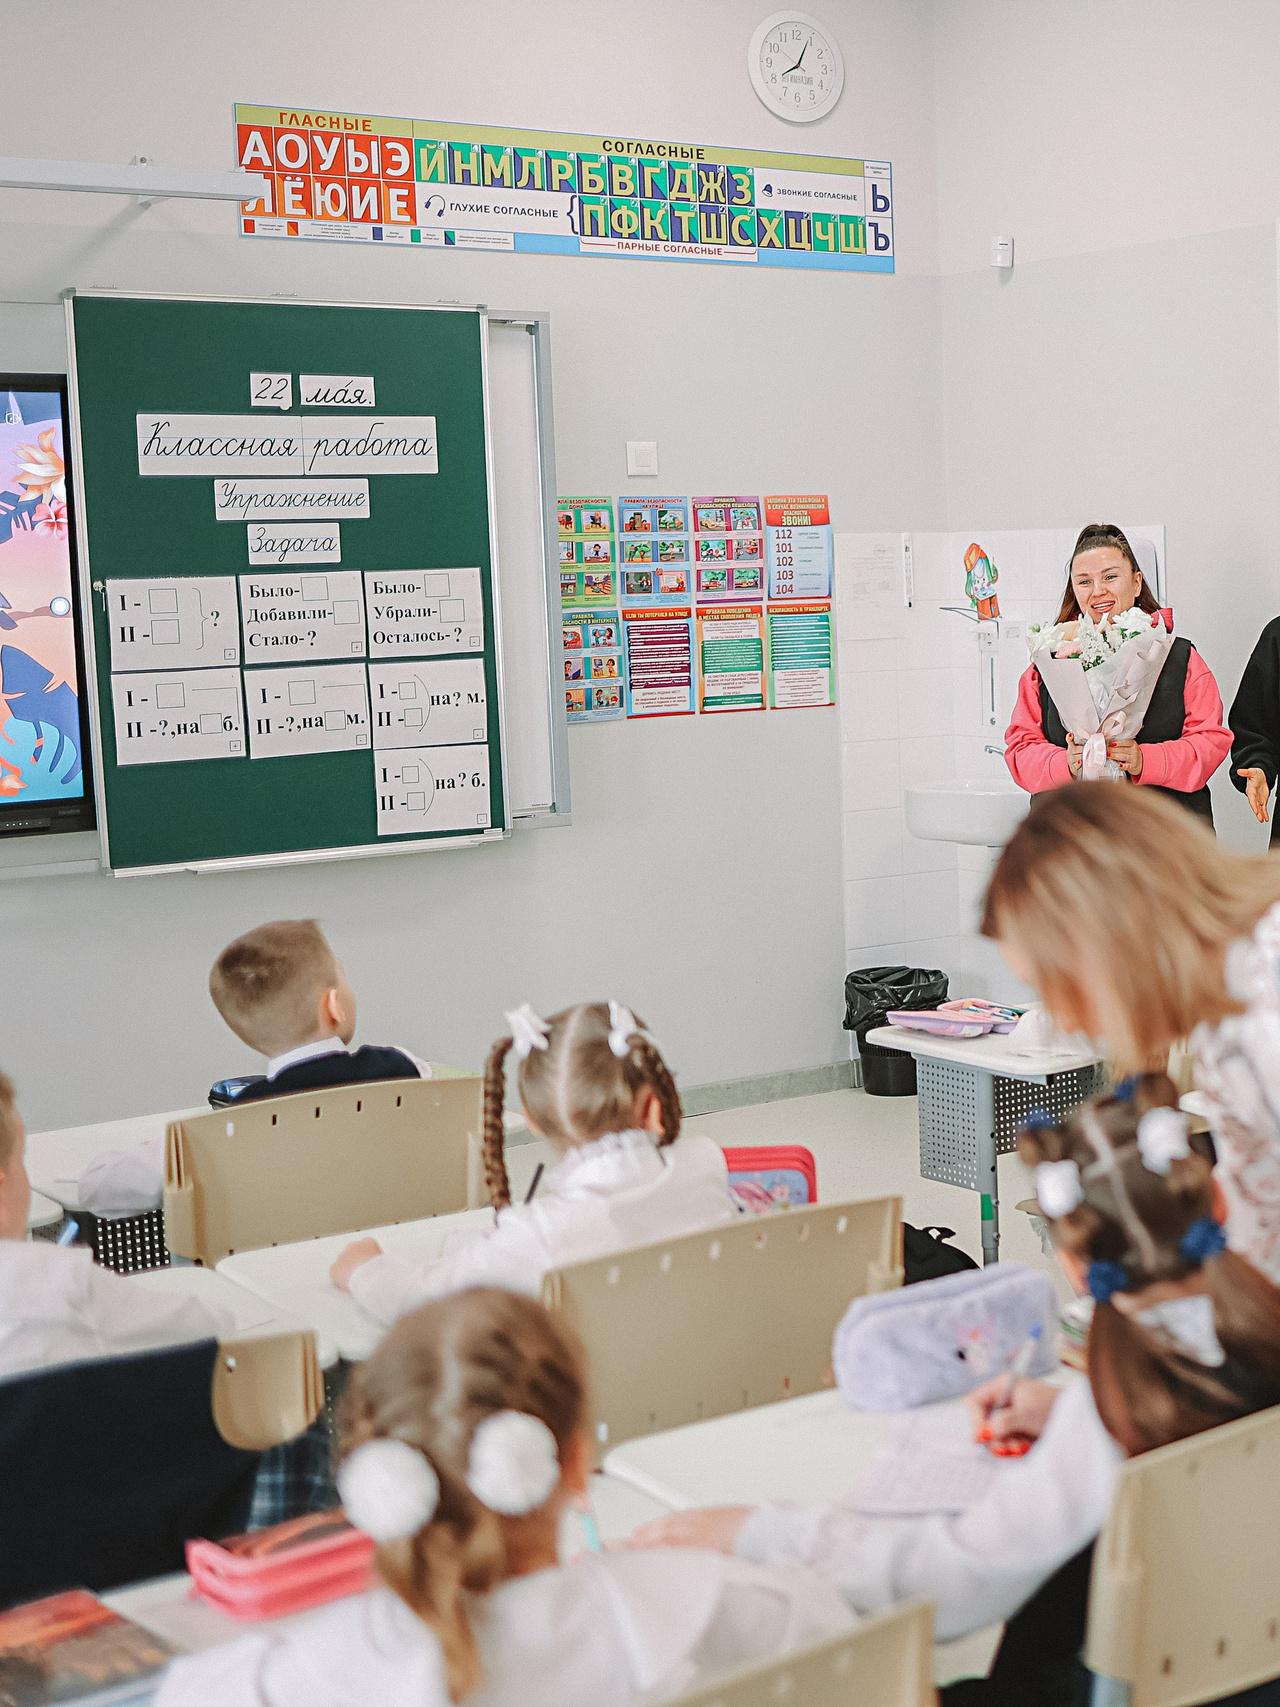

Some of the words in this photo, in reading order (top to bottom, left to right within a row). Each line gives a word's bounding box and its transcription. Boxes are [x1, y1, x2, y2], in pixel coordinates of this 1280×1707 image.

[780, 32, 787, 42] 11
[792, 30, 801, 40] 12
[810, 37, 812, 46] 1
[769, 43, 779, 53] 10
[817, 49, 823, 59] 2
[766, 58, 772, 67] 9
[822, 65, 827, 75] 3
[771, 74, 777, 83] 8
[818, 80, 823, 89] 4
[782, 87, 788, 96] 7
[809, 90, 815, 100] 5
[795, 92, 800, 102] 6
[279, 112, 372, 132] ГЛАСНЫЕ
[602, 140, 705, 160] СОГЛАСНЫЕ
[777, 188, 811, 198] ЗВОНКИЕ
[813, 191, 858, 201] СОГЛАСНЫЕ
[450, 203, 490, 214] ГЛУХИЕ
[493, 206, 561, 218] СОГЛАСНЫЕ
[617, 241, 662, 253] ПАРНЫЕ
[664, 244, 723, 256] СОГЛАСНЫЕ
[255, 378, 288, 401] 22
[143, 421, 298, 457] Классная
[309, 423, 433, 471] работа
[219, 483, 366, 519] Упражнение
[781, 516, 811, 525] ЗВОНИ!
[776, 529, 792, 539] 112
[250, 527, 337, 562] Задача
[776, 543, 793, 552] 101
[777, 557, 793, 566] 102
[777, 570, 794, 580] 103
[776, 584, 794, 594] 104
